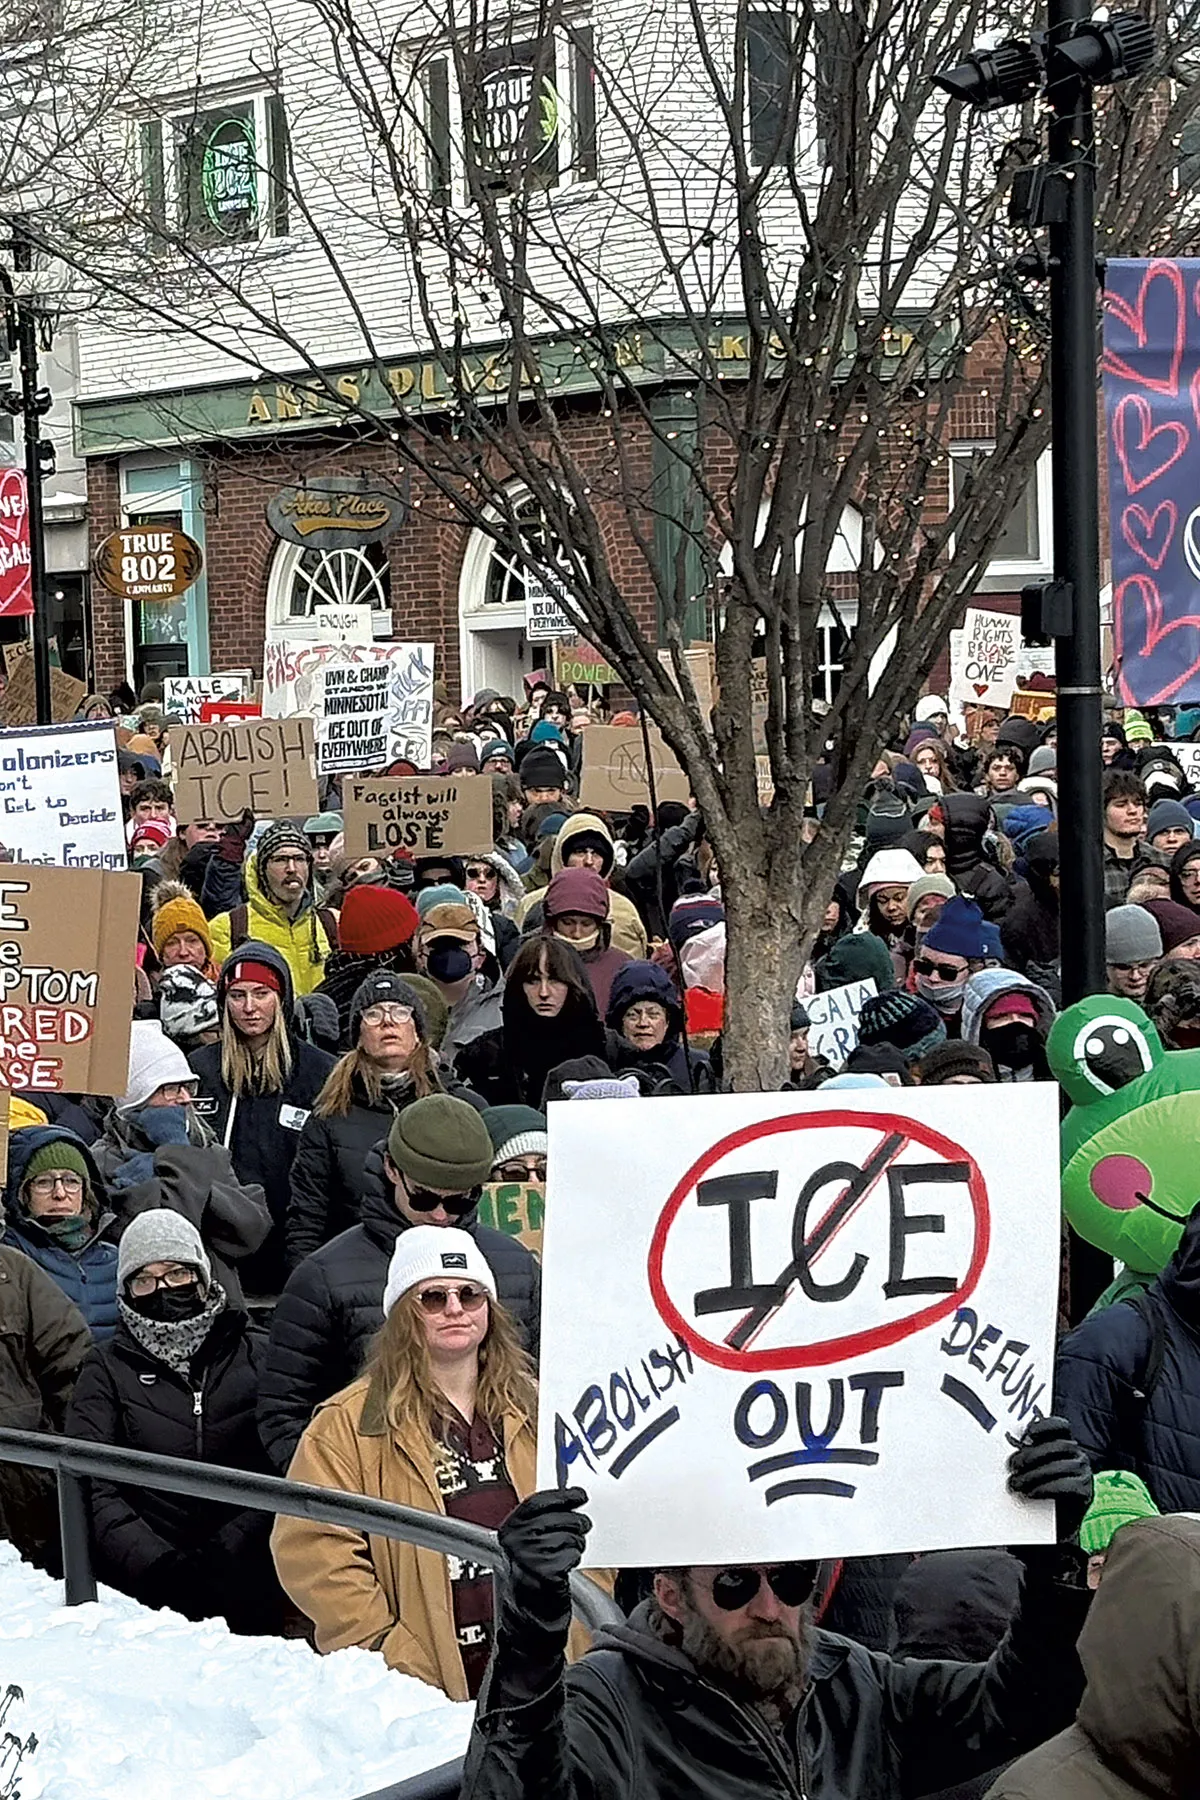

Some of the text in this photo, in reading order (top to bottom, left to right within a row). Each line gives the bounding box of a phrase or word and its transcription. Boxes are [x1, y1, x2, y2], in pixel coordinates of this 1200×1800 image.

[484, 75, 533, 110] TRUE
[335, 494, 391, 516] Place
[120, 533, 175, 554] TRUE
[121, 554, 177, 583] 802
[319, 613, 359, 629] ENOUGH
[974, 613, 1013, 629] HUMAN
[972, 627, 1014, 643] RIGHTS
[346, 669, 359, 684] &
[561, 661, 618, 682] POWER
[965, 661, 1004, 682] ONE
[170, 679, 224, 695] KALE
[324, 684, 375, 696] STANDS
[186, 694, 212, 706] NOT
[323, 690, 389, 717] MINNESOTA!
[327, 716, 384, 741] ICE OUT OF
[180, 722, 306, 768] ABOLISH
[45, 796, 68, 809] to
[423, 787, 458, 804] will
[59, 808, 117, 827] Decide
[382, 807, 450, 828] always
[367, 822, 444, 851] LOSE
[62, 842, 125, 871] Foreign
[693, 1160, 971, 1316] ICE
[554, 1331, 694, 1488] ABOLISH
[733, 1369, 905, 1450] OUT
